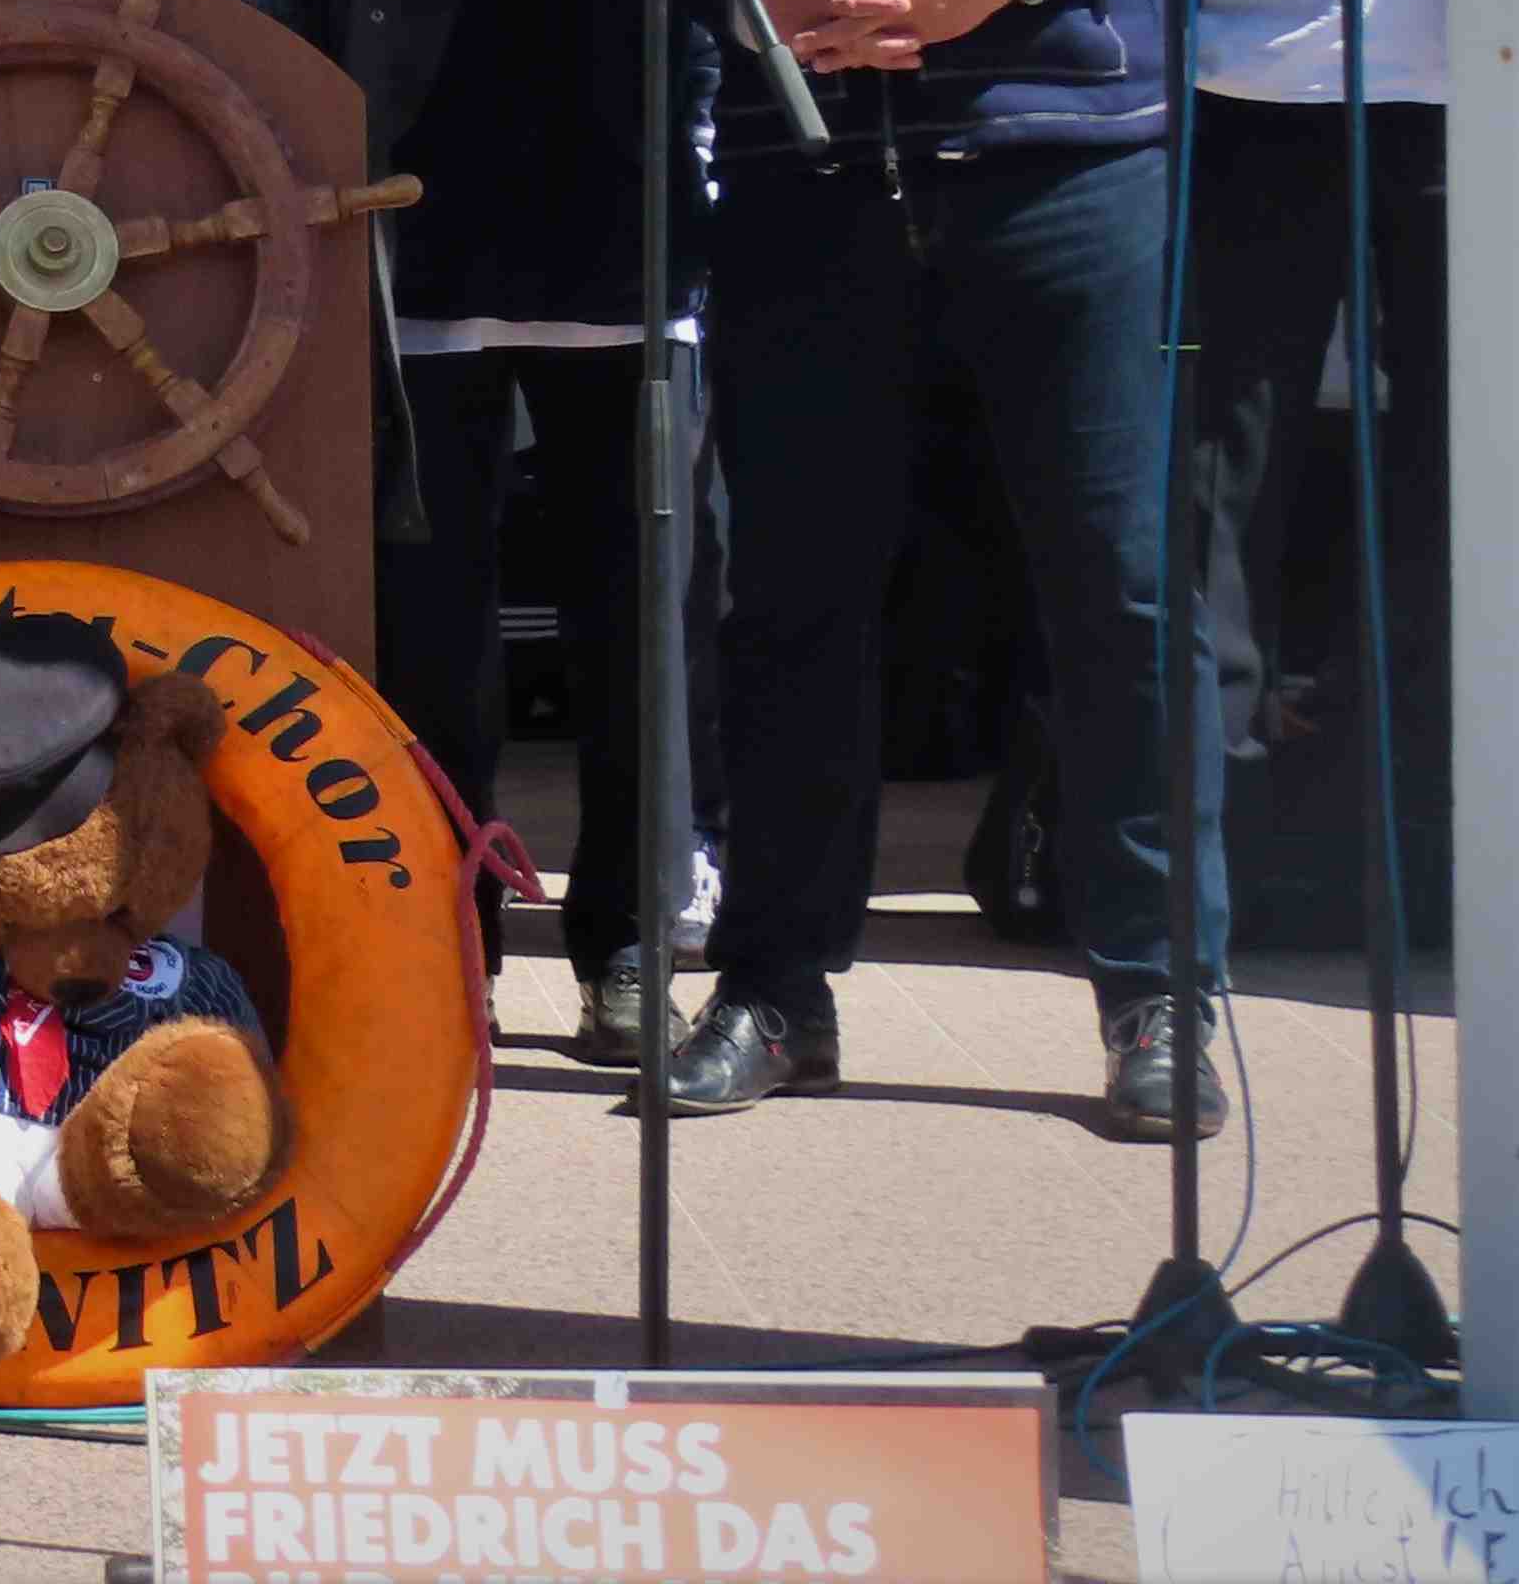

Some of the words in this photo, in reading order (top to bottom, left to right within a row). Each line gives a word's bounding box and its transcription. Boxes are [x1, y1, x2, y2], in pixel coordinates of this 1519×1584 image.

[197, 1411, 442, 1487] JETZT
[471, 1417, 728, 1495] MUSS
[203, 1490, 665, 1572] FRIEDRICH
[694, 1501, 878, 1575] DAS
